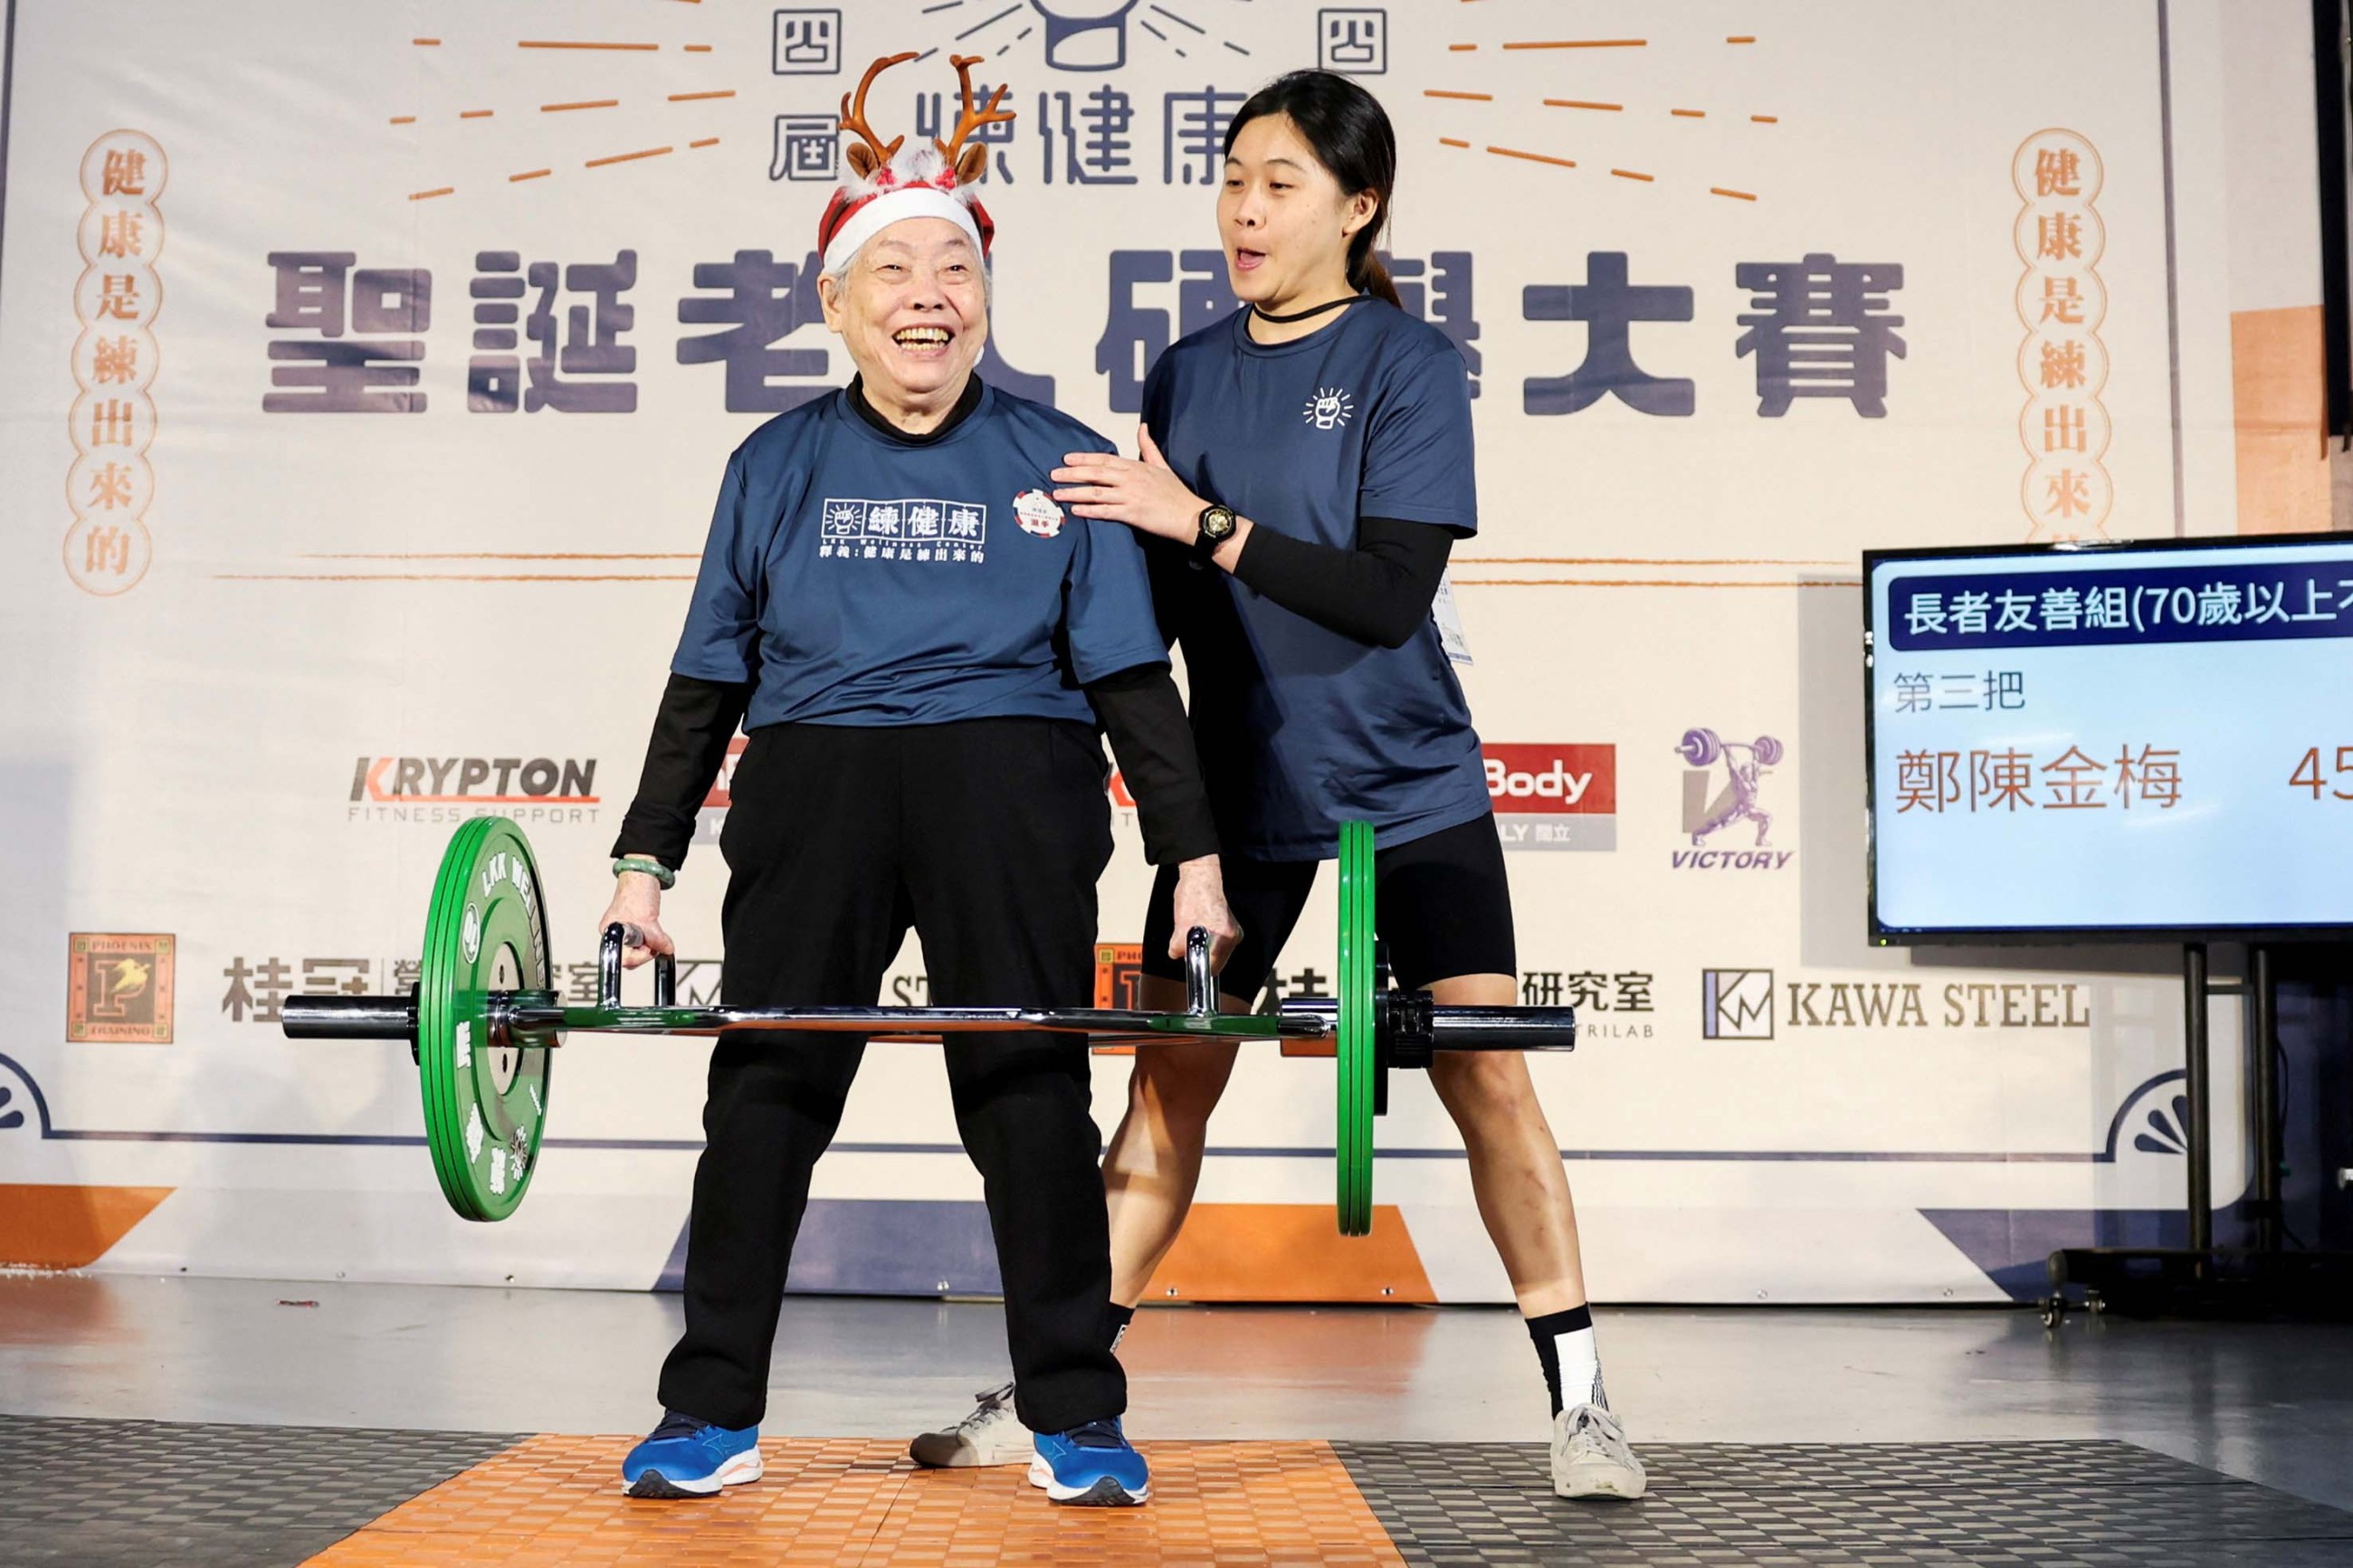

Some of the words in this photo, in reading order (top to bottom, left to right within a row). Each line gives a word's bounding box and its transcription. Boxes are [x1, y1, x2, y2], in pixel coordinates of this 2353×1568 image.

[85, 147, 147, 575] 健康是練出來的
[2034, 147, 2092, 542] 健康是練出來
[867, 505, 979, 537] 練健康
[1893, 670, 2027, 714] 第三把
[349, 756, 597, 803] KRYPTON
[1895, 742, 2184, 814] 鄭陳金梅
[348, 807, 462, 822] FITNESS
[1672, 850, 1796, 869] VICTORY
[1786, 983, 1929, 1027] KAWA
[1943, 983, 2091, 1028] STEEL
